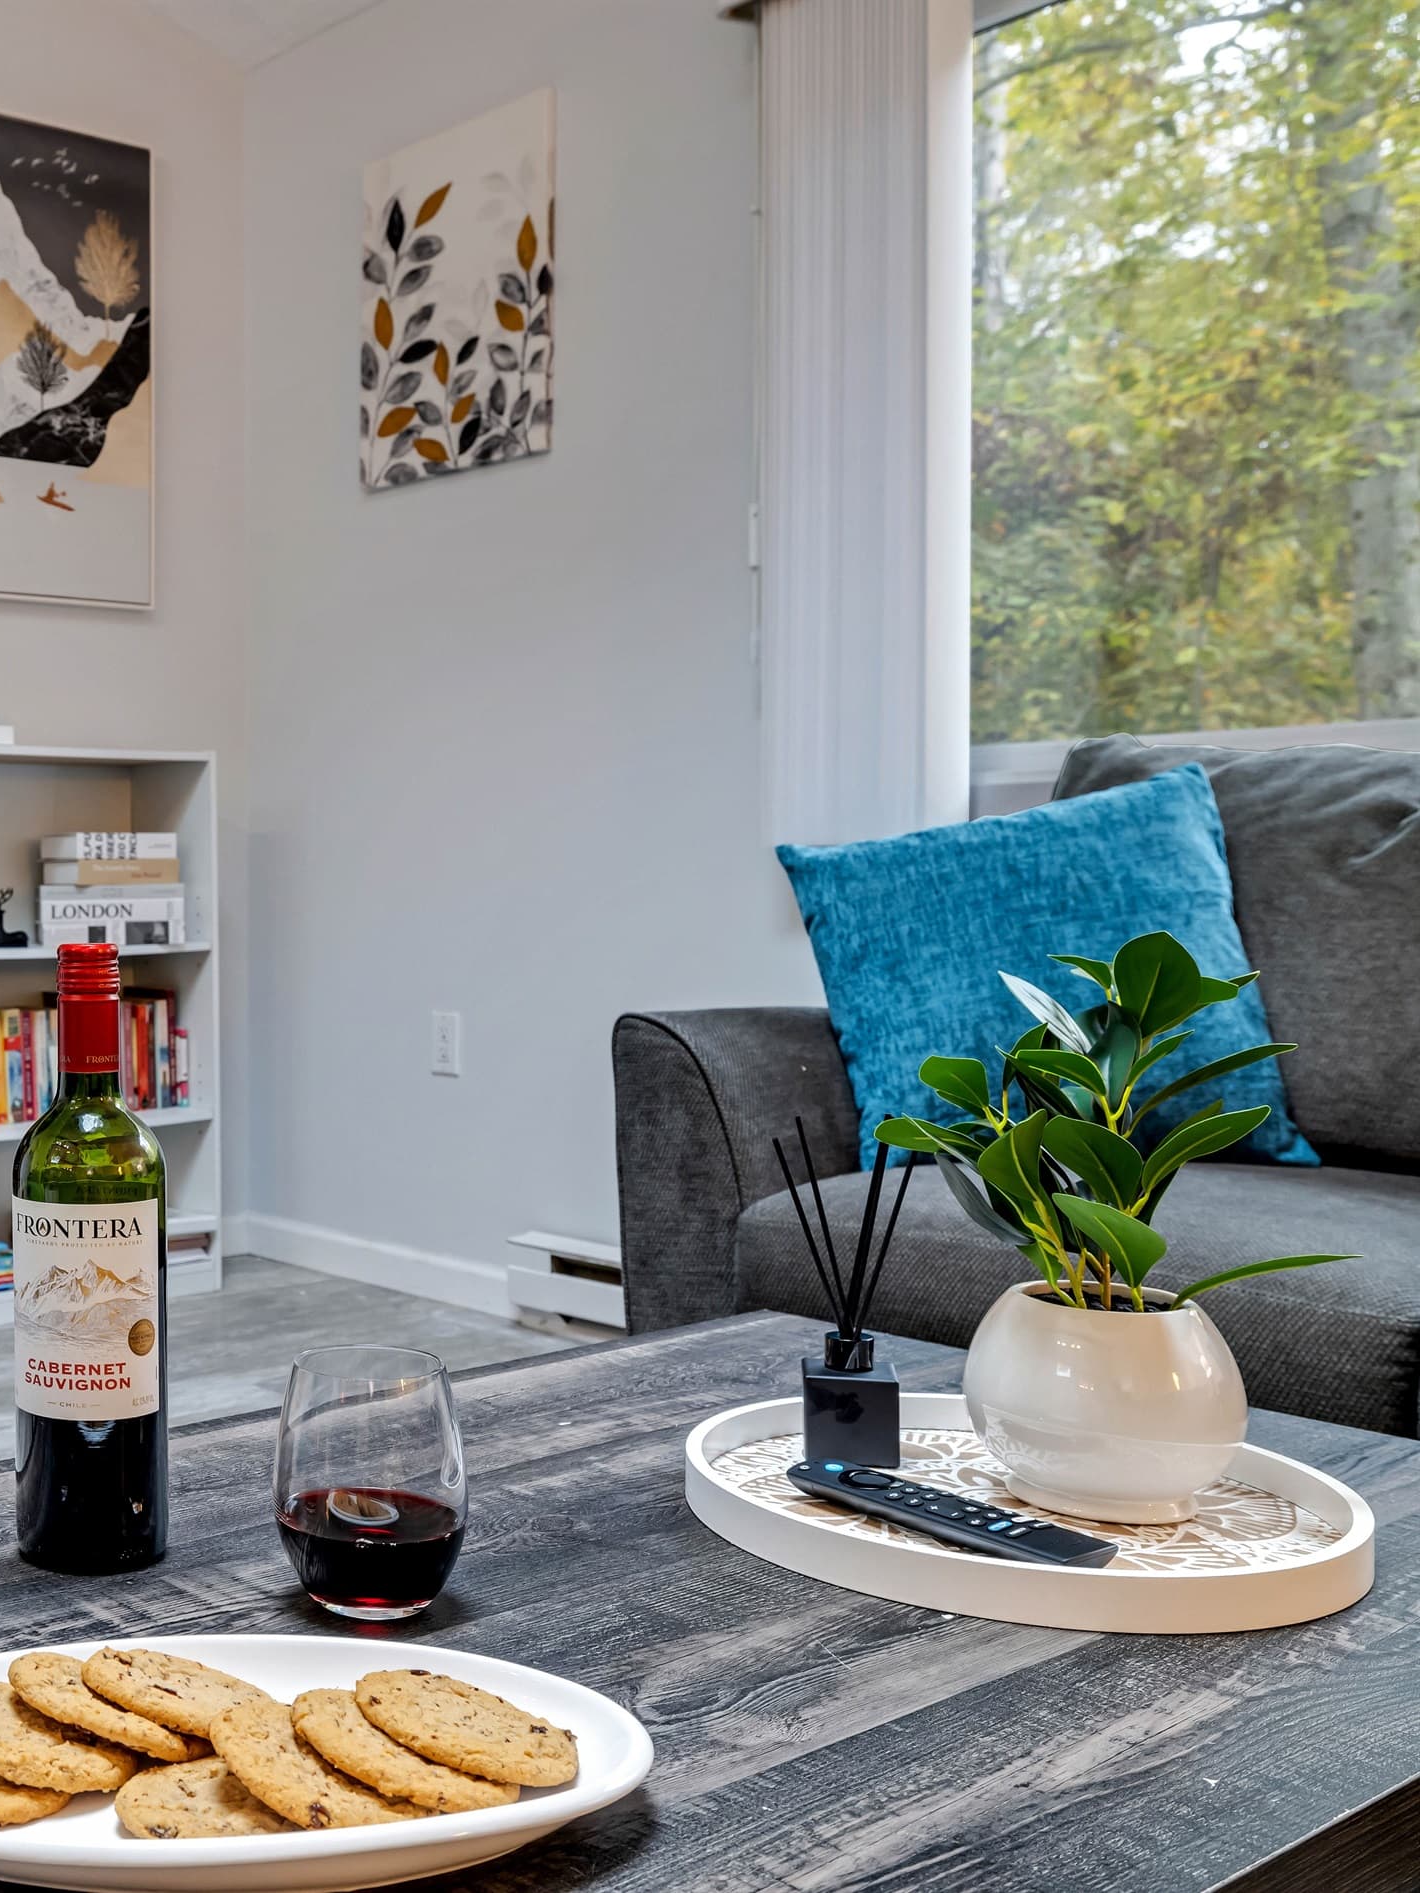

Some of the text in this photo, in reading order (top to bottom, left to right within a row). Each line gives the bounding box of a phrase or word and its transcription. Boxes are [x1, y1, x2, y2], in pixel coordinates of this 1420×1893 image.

[51, 904, 133, 920] LONDON
[16, 1212, 143, 1240] FRONTERA
[28, 1358, 127, 1376] CABERNET
[25, 1371, 131, 1391] SAUVIGNON
[59, 1401, 87, 1409] CHILE
